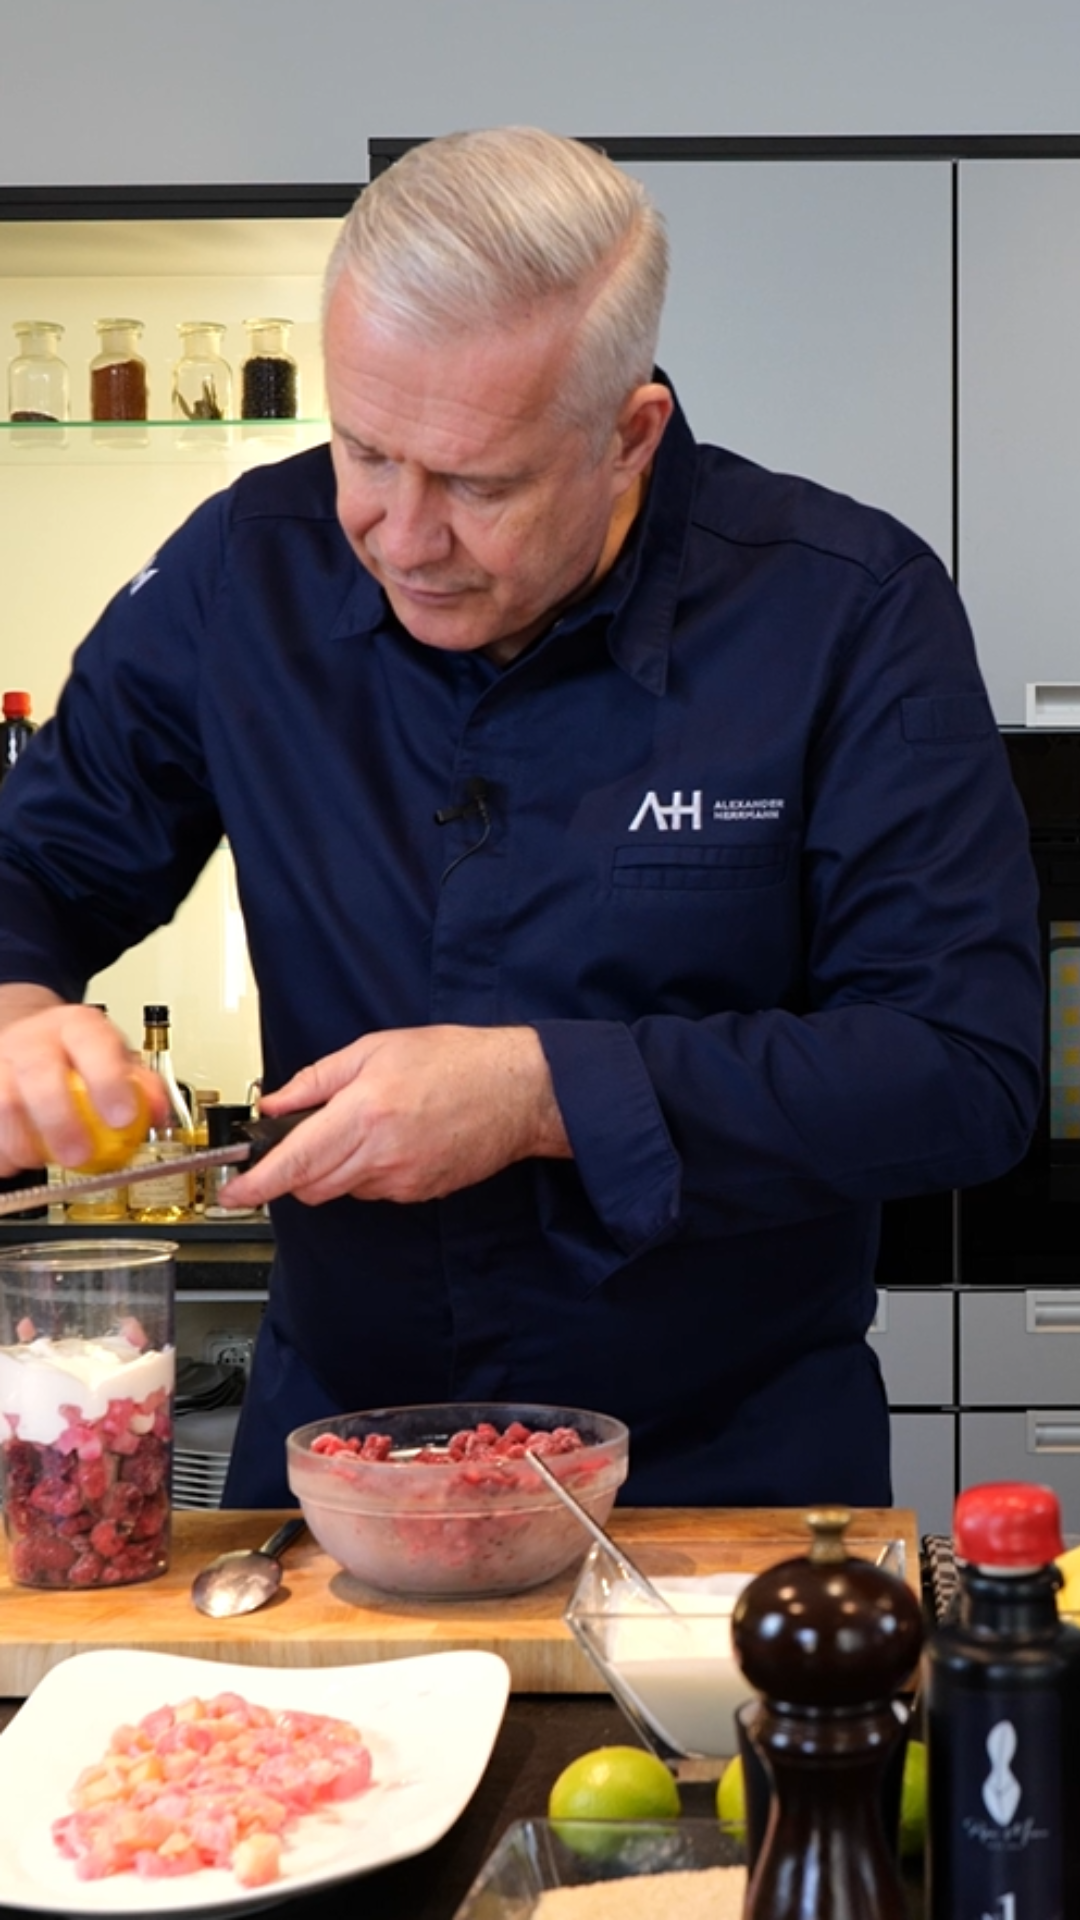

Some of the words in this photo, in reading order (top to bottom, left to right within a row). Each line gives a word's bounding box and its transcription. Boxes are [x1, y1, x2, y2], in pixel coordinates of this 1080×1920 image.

[628, 790, 702, 830] AH
[714, 799, 784, 810] ALEXANDER
[714, 810, 779, 820] HERRMANN
